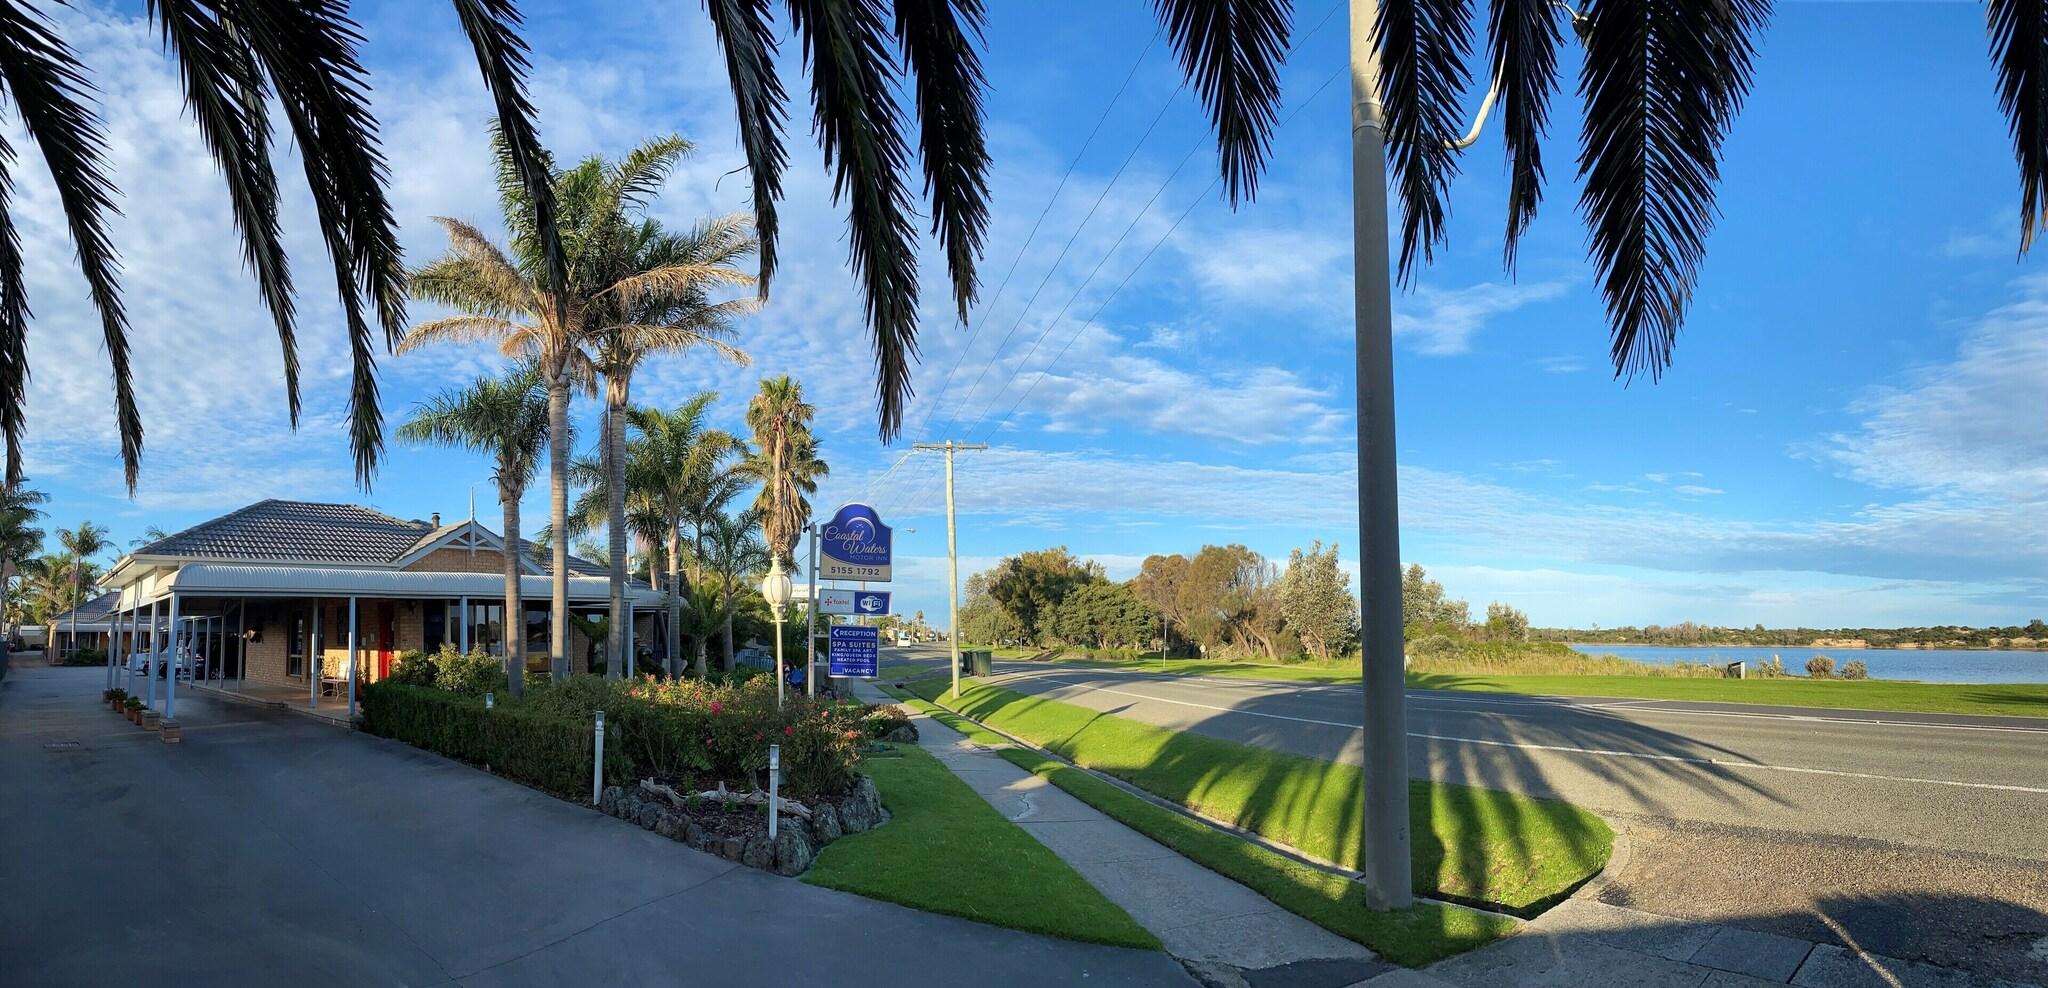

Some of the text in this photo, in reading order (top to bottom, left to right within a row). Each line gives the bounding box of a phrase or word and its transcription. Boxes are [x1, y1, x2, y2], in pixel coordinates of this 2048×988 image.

[825, 525, 865, 541] Coastal
[843, 540, 887, 555] Waters
[831, 566, 880, 576] 5155 1792
